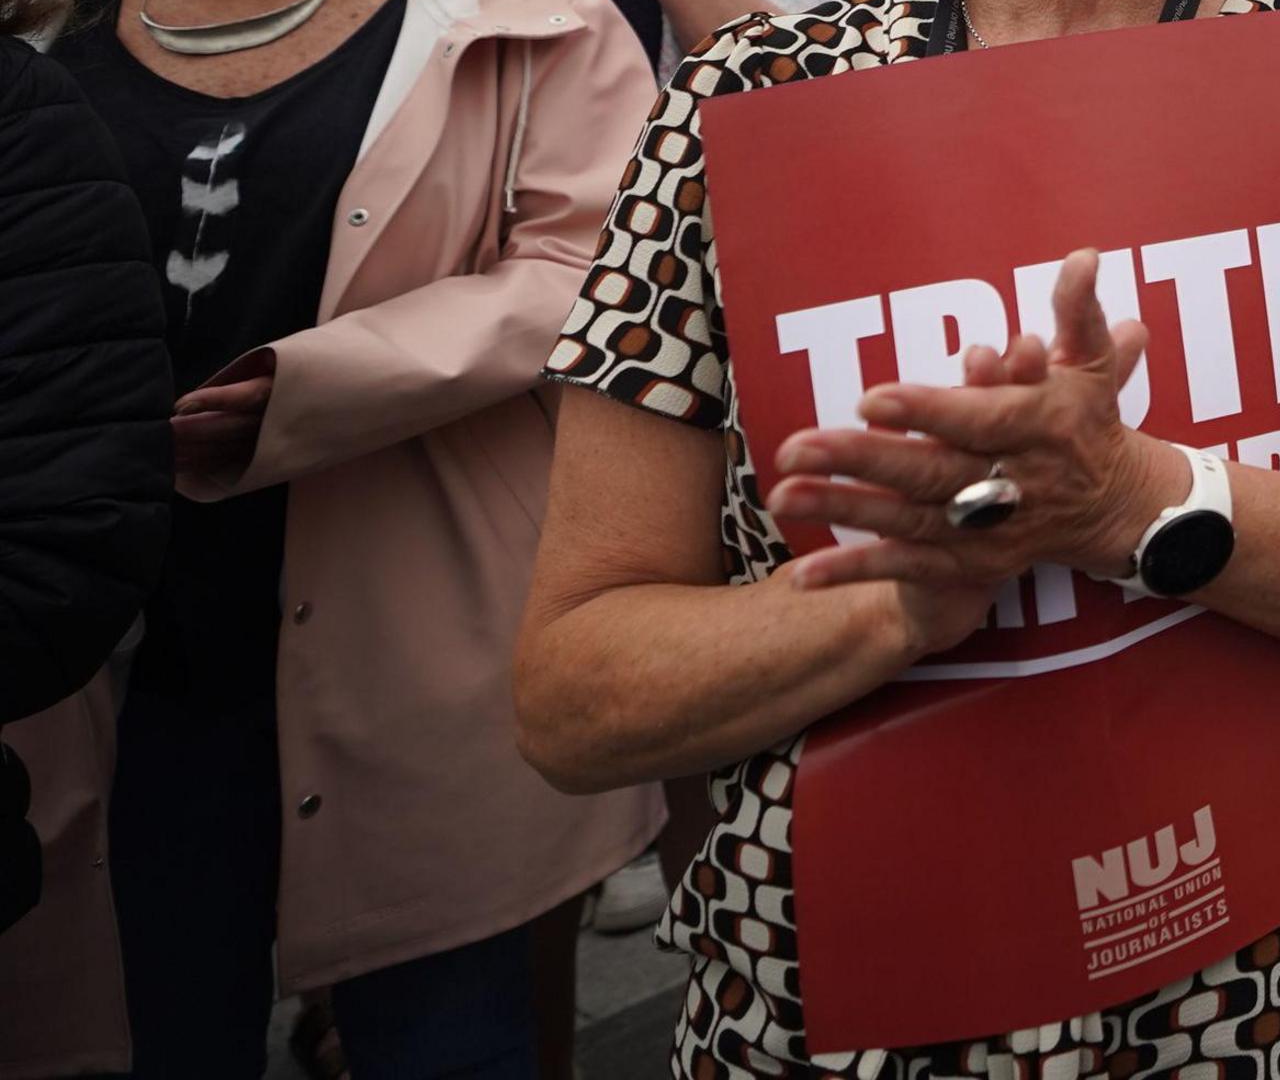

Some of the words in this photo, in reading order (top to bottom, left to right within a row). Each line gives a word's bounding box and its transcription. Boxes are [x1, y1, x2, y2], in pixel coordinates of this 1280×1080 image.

[1071, 804, 1217, 911] NUJ
[1081, 895, 1169, 935] NATIONAL
[1174, 865, 1222, 900] UNION
[1087, 899, 1227, 970] JOURNALISTS
[1149, 913, 1169, 930] OF
